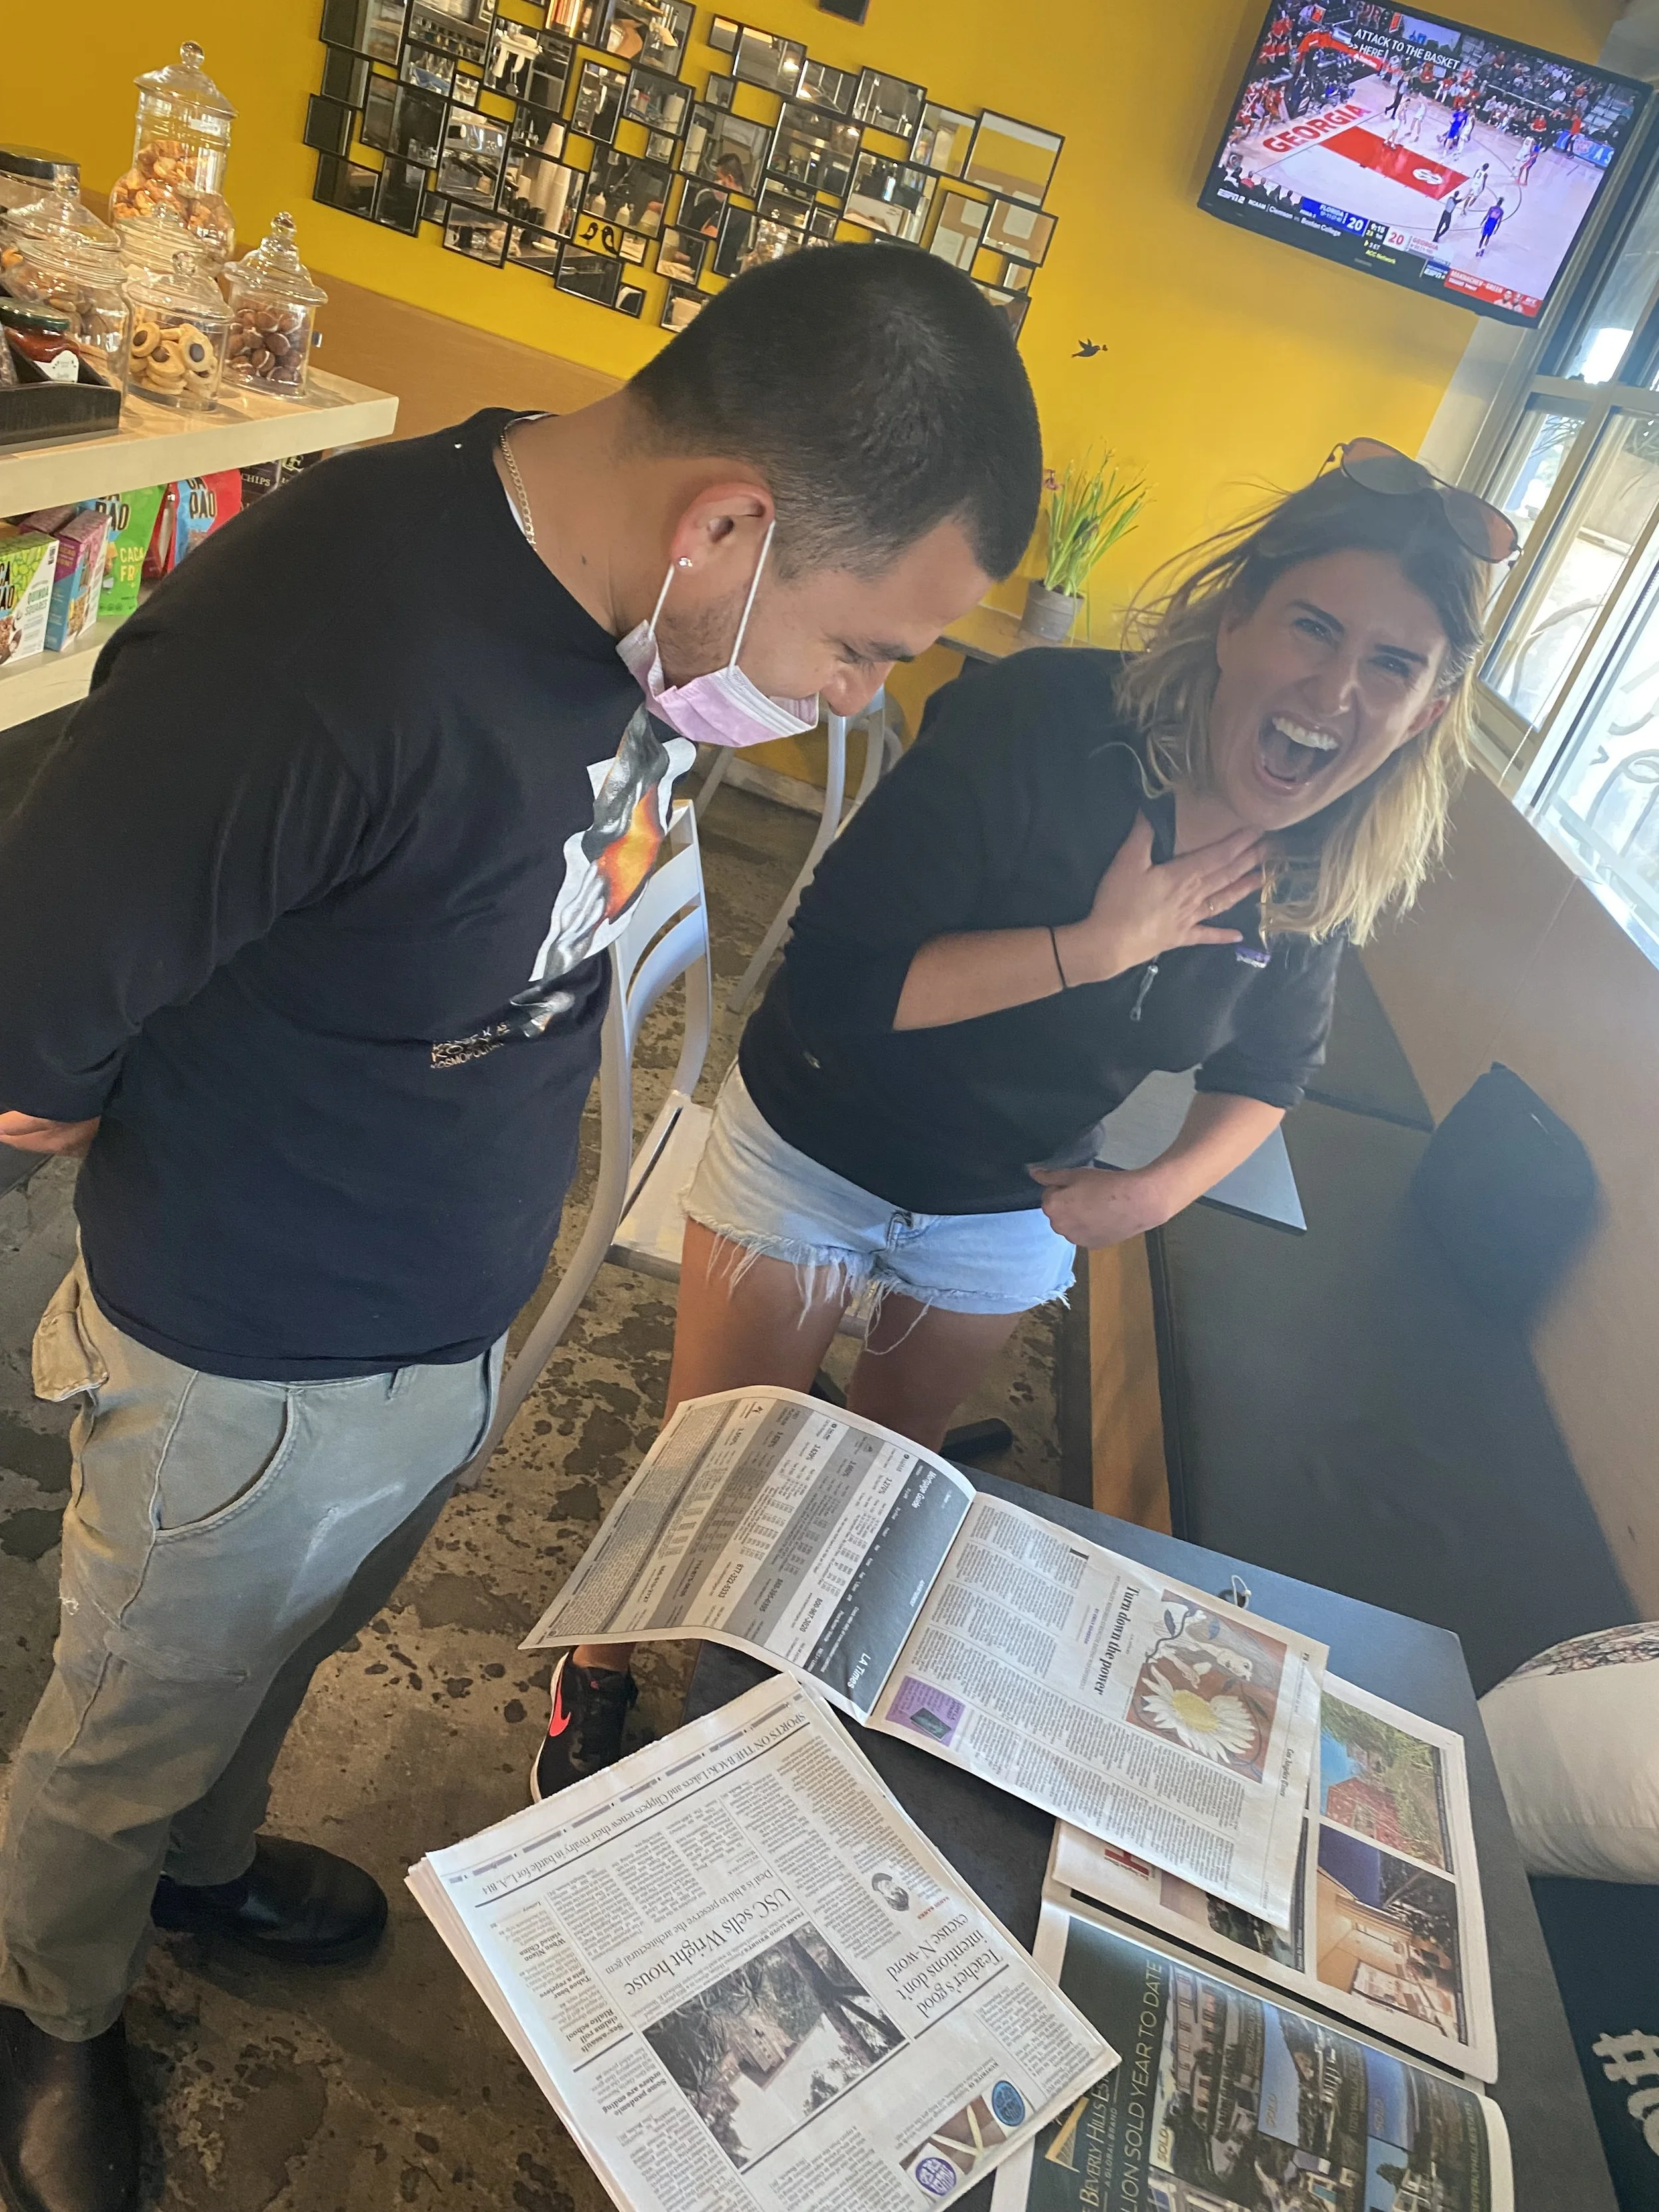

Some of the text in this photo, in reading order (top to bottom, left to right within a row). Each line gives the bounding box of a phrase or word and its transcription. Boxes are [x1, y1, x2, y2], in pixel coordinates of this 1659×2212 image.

[1354, 27, 1460, 70] ATTACK TO THE BASKET
[1358, 43, 1384, 58] HERE
[1262, 102, 1372, 153] GEORGIA
[1216, 187, 1246, 204] ESPN2
[1268, 205, 1293, 219] Clemson
[1300, 217, 1321, 229] Boston
[1319, 224, 1342, 238] College
[1346, 216, 1364, 233] 20
[1370, 222, 1386, 234] 9:15
[1388, 230, 1405, 246] 20
[241, 473, 270, 486] CHIPS
[119, 546, 143, 562] CACA
[909, 1469, 938, 1510] Mortgage Guide
[798, 1476, 893, 1633] 3.270% 800-967-3020
[1089, 1585, 1141, 1696] Turn down the power
[845, 1652, 872, 1691] LA Times
[766, 1711, 808, 1741] SPORTS
[732, 1743, 757, 1762] THE
[753, 1734, 772, 1751] ON
[680, 1769, 709, 1792] Lakers
[705, 1755, 736, 1777] BACK:
[1277, 1747, 1295, 1798] Los Angeles Times
[632, 1790, 670, 1818] Clippers
[666, 1783, 684, 1800] and
[589, 1824, 613, 1843] their
[610, 1810, 635, 1829] renew
[553, 1848, 565, 1862] in
[562, 1832, 592, 1856] rivalry
[515, 1866, 532, 1881] for
[528, 1853, 556, 1875] battle
[495, 1872, 518, 1891] L.A.
[604, 1868, 773, 1976] Deal is a bid to preserve the architectural gem
[768, 1922, 787, 1937] LLOYD
[786, 1910, 805, 1925] FRANK
[518, 1930, 561, 1958] visited China
[523, 1935, 566, 1964] When Nixon
[622, 1884, 793, 2002] USC sells Wright house
[885, 1911, 971, 1983] excuse N-word
[570, 1967, 586, 1980] gets
[895, 1927, 988, 2005] intentions don't
[538, 1978, 567, 1999] reprieve
[552, 1974, 591, 2000] Tahoe bear
[912, 1945, 1004, 2020] Teacher's good
[1141, 1958, 1165, 2007] DATE
[564, 2007, 614, 2041] Rialto school
[578, 2014, 619, 2043] claims roil
[579, 2022, 625, 2053] Sex-assault
[1137, 2010, 1157, 2038] TO
[1129, 2041, 1153, 2098] YEAR
[601, 2070, 662, 2114] orders are ending
[611, 2077, 667, 2118] Some pandemic
[1107, 2106, 1119, 2140] BRAND
[1264, 2093, 1277, 2125] SOLD
[1373, 2099, 1386, 2131] SOLD
[1122, 2101, 1147, 2160] SOLD
[1156, 2128, 1169, 2162] SOLD
[1078, 2102, 1109, 2207] BEVERLY HILLS
[1104, 2144, 1116, 2179] GLOBAL
